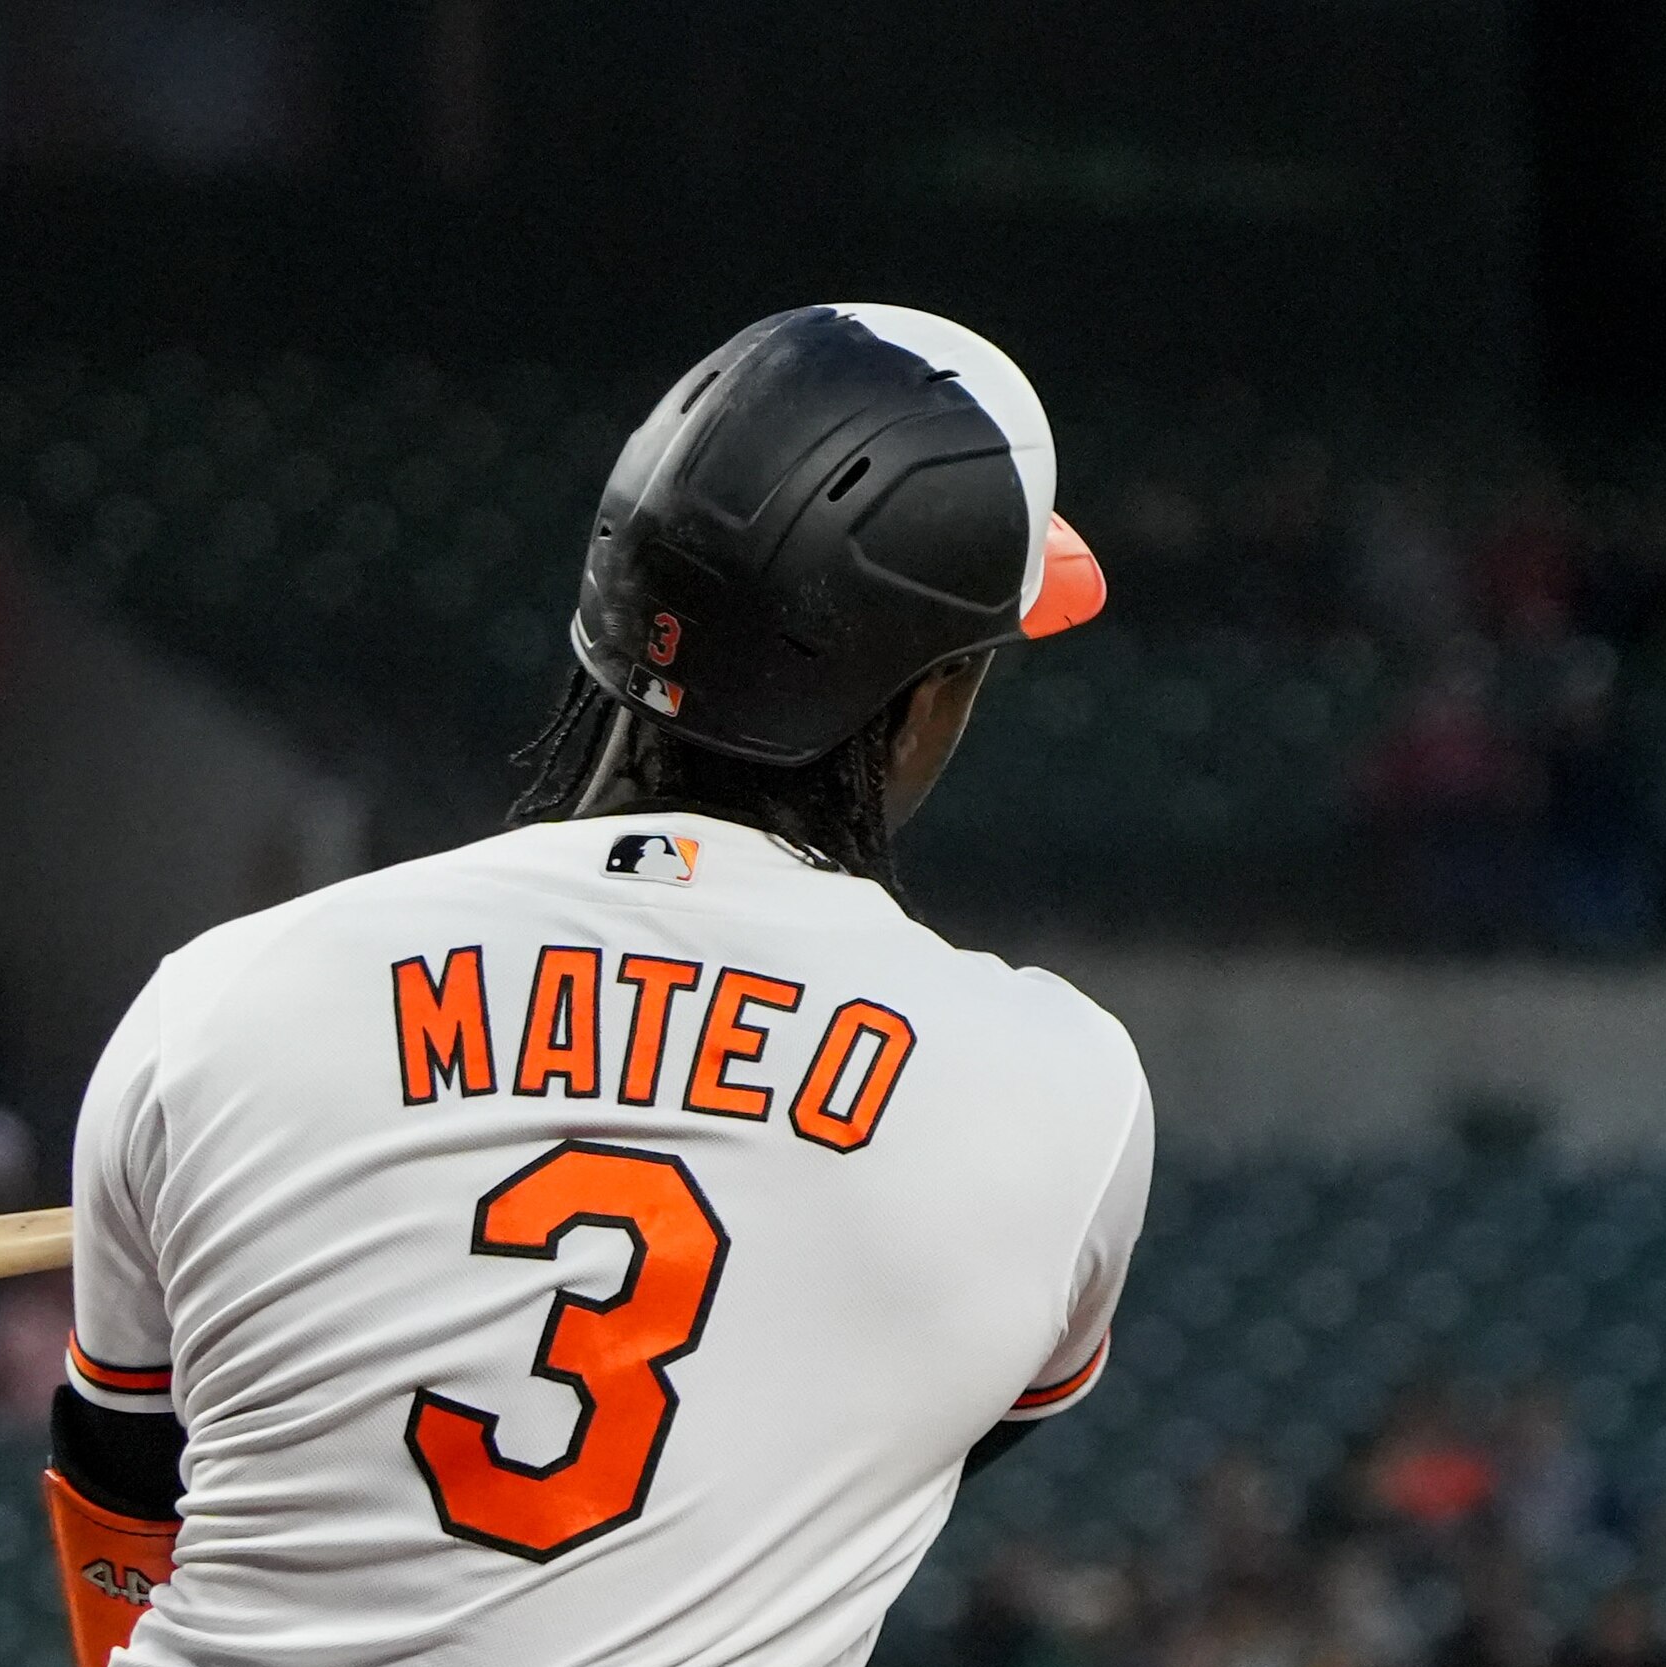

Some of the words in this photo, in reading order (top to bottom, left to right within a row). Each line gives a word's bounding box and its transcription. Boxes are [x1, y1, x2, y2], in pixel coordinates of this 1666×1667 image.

[648, 612, 681, 666] 3
[391, 945, 917, 1154] MATEO
[404, 1139, 731, 1564] 3
